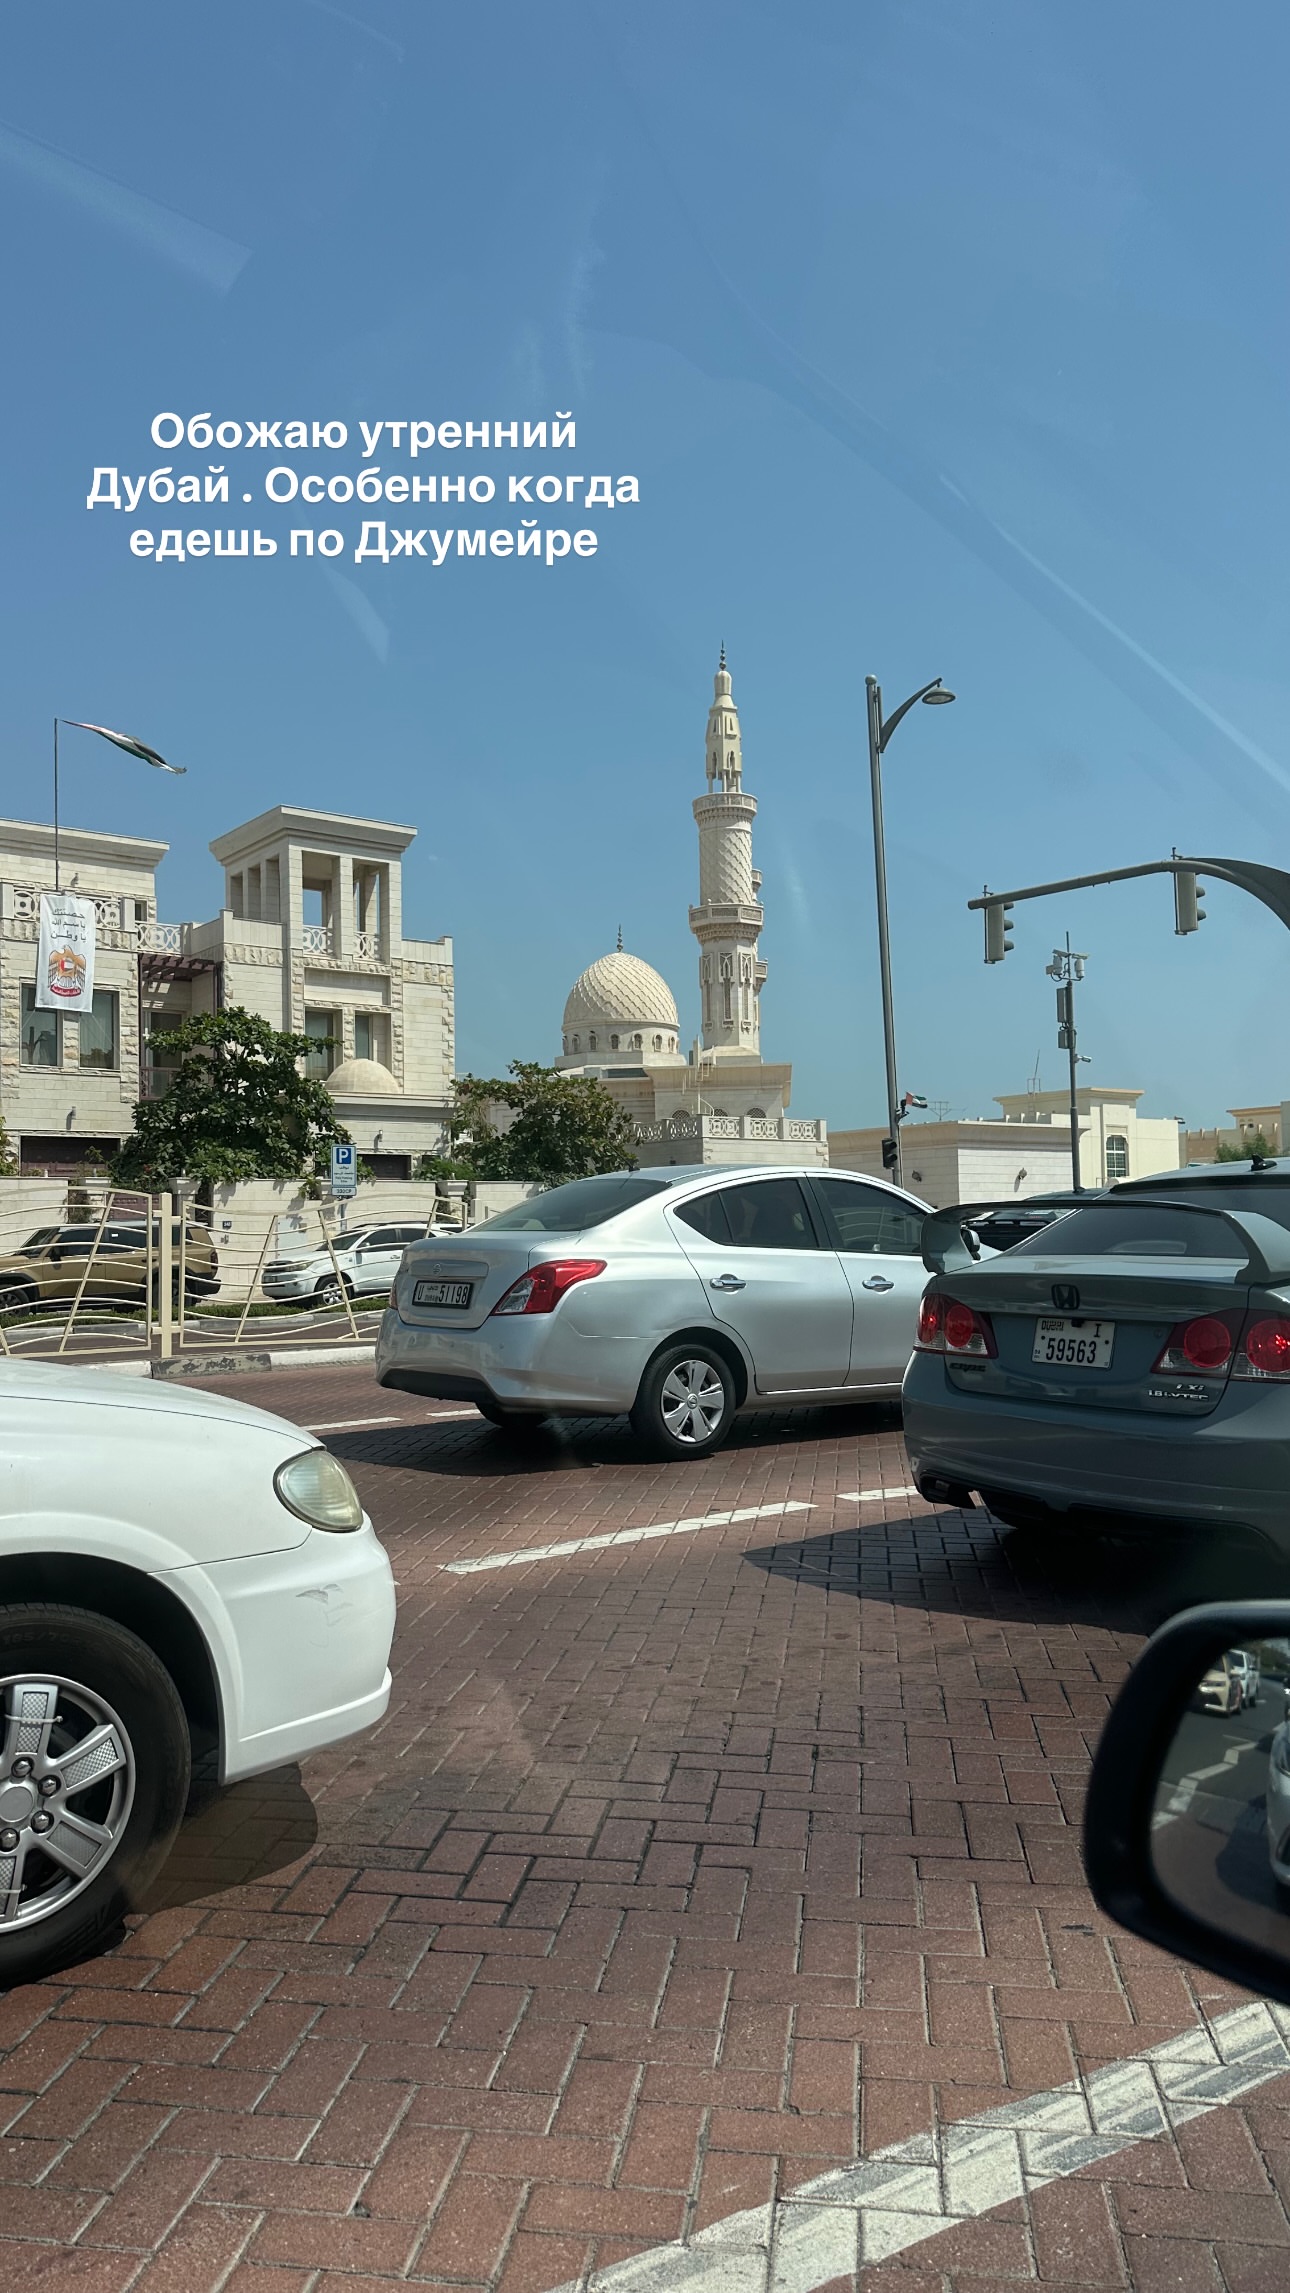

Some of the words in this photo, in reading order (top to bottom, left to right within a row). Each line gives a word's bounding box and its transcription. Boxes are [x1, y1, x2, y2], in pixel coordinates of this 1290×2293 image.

[338, 1149, 349, 1164] P
[438, 1284, 469, 1304] 51198
[1045, 1337, 1097, 1364] 59563
